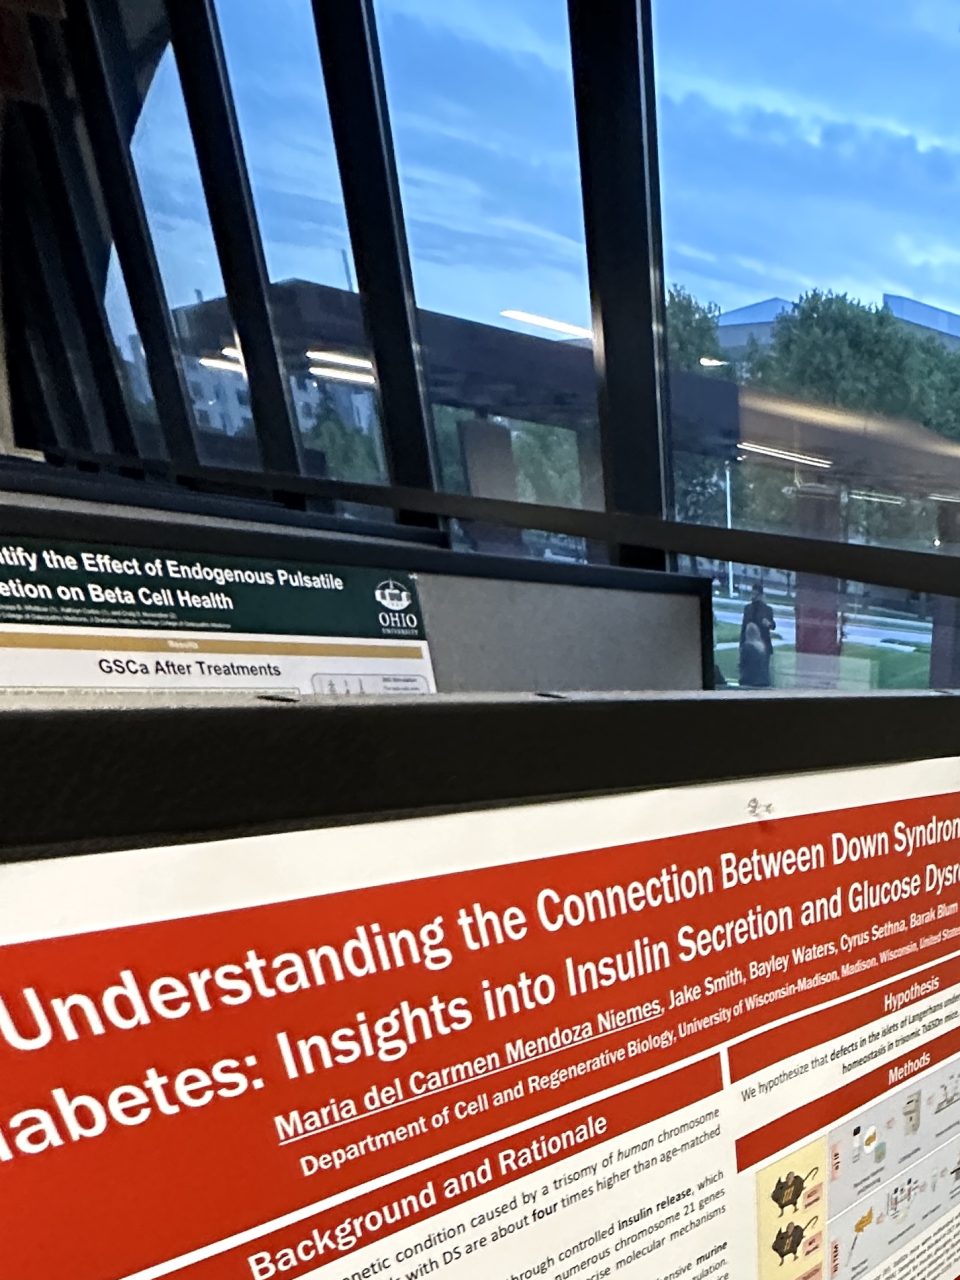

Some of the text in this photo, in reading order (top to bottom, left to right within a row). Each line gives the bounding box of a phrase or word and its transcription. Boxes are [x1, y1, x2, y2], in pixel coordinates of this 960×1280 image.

[0, 546, 344, 590] tify the Effect of Endogenous Pulsatile
[0, 578, 234, 610] etion on Beta Cell Health
[378, 612, 418, 628] OHIO
[99, 659, 281, 677] GSCa After Treatments
[0, 915, 452, 1051] Understanding
[456, 902, 527, 950] the
[536, 863, 713, 932] Connection
[719, 842, 824, 889] Between
[831, 831, 889, 865] Down
[275, 994, 472, 1079] Insights
[481, 971, 555, 1021] into
[564, 936, 670, 996] Insulin
[677, 904, 793, 962] Secretion
[800, 886, 842, 926] and
[847, 873, 921, 913] Glucose
[273, 901, 958, 1140] Maria del Carmen Mendoza Niemes, Jake Smith, Bayley Waters, Cyrus Sethna, Barak Blum
[883, 975, 939, 1012] Hypothesis
[299, 1116, 428, 1176] Department
[430, 1105, 449, 1128] of
[453, 1092, 489, 1119] Cell
[492, 1080, 524, 1106] and
[526, 1047, 625, 1094] Regenerative
[626, 1029, 677, 1057] Biology,
[677, 1007, 732, 1038] University
[732, 998, 743, 1016] of
[743, 969, 840, 1011] Wisconsin-Madison,
[918, 930, 942, 949] United
[740, 1015, 908, 1102] We hypothesize that defects in the islets of
[888, 1051, 930, 1085] Methods
[394, 1222, 466, 1263] condition
[469, 1195, 518, 1228] caused
[520, 1189, 537, 1205] by
[541, 1184, 549, 1196] a
[552, 1162, 597, 1190] trisomy
[601, 1151, 613, 1168] of
[616, 1137, 654, 1162] human
[657, 1108, 719, 1143] chromosome
[441, 1245, 462, 1265] DS
[464, 1236, 487, 1254] are
[490, 1215, 529, 1242] about
[531, 1201, 558, 1222] four
[560, 1185, 594, 1208] times
[595, 1167, 630, 1192] higher
[632, 1156, 658, 1174] than
[659, 1123, 721, 1163] age-matched
[442, 1157, 492, 1198] and
[497, 1115, 607, 1175] Rationale
[557, 1222, 615, 1262] controlled
[617, 1206, 653, 1231] insulin
[696, 1169, 724, 1191] which
[613, 1211, 680, 1252] chromosome
[682, 1201, 695, 1216] 21
[698, 1187, 725, 1211] genes
[615, 1236, 666, 1270] molecular
[669, 1204, 726, 1241] mechanisms
